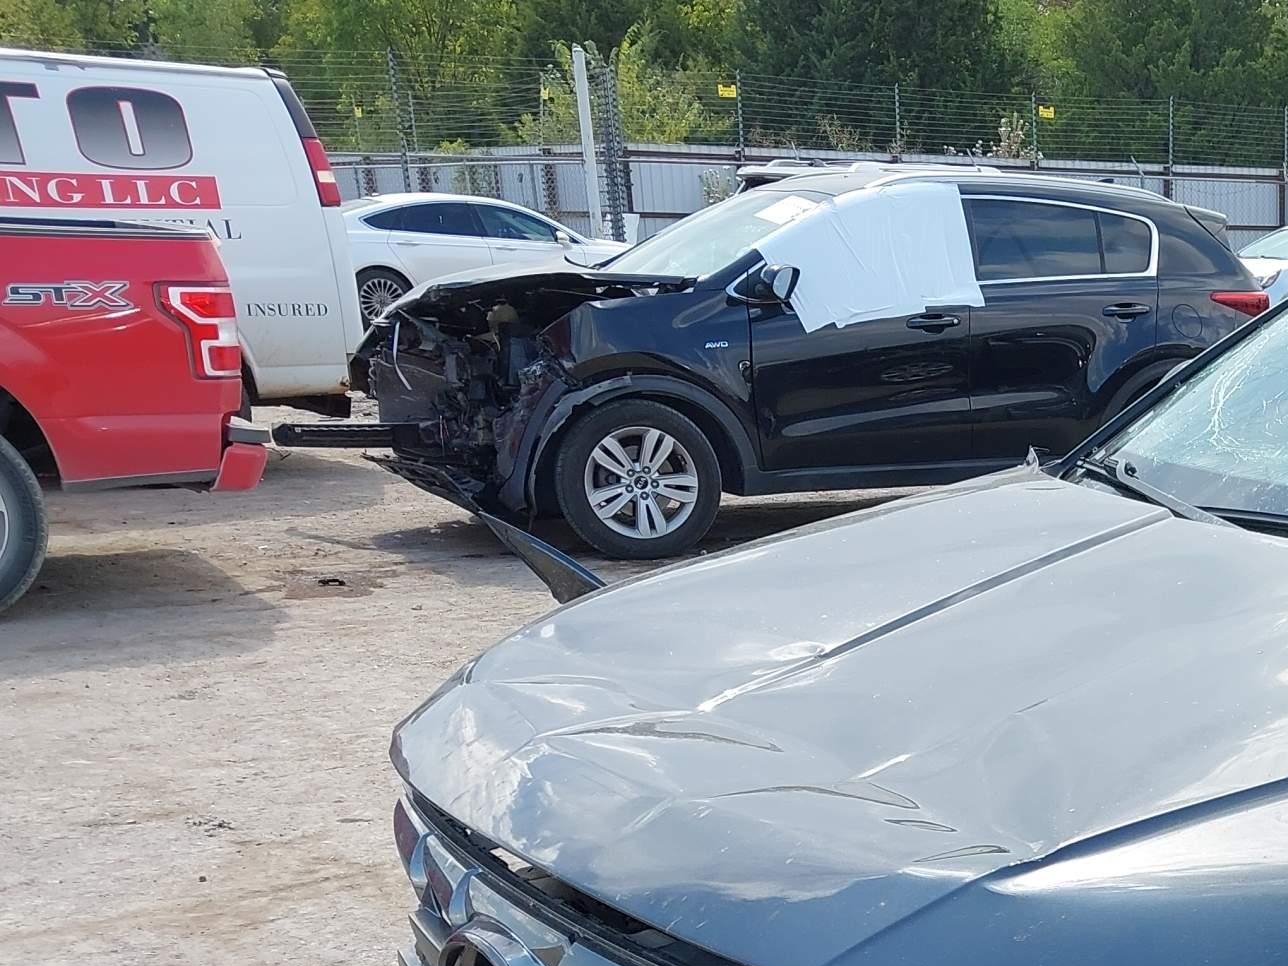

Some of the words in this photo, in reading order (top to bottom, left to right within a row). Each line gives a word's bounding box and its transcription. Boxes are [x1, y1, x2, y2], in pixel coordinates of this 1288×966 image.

[96, 179, 201, 206] LLC
[3, 281, 134, 310] STX
[247, 303, 328, 317] INSURED
[705, 341, 729, 349] AWD
